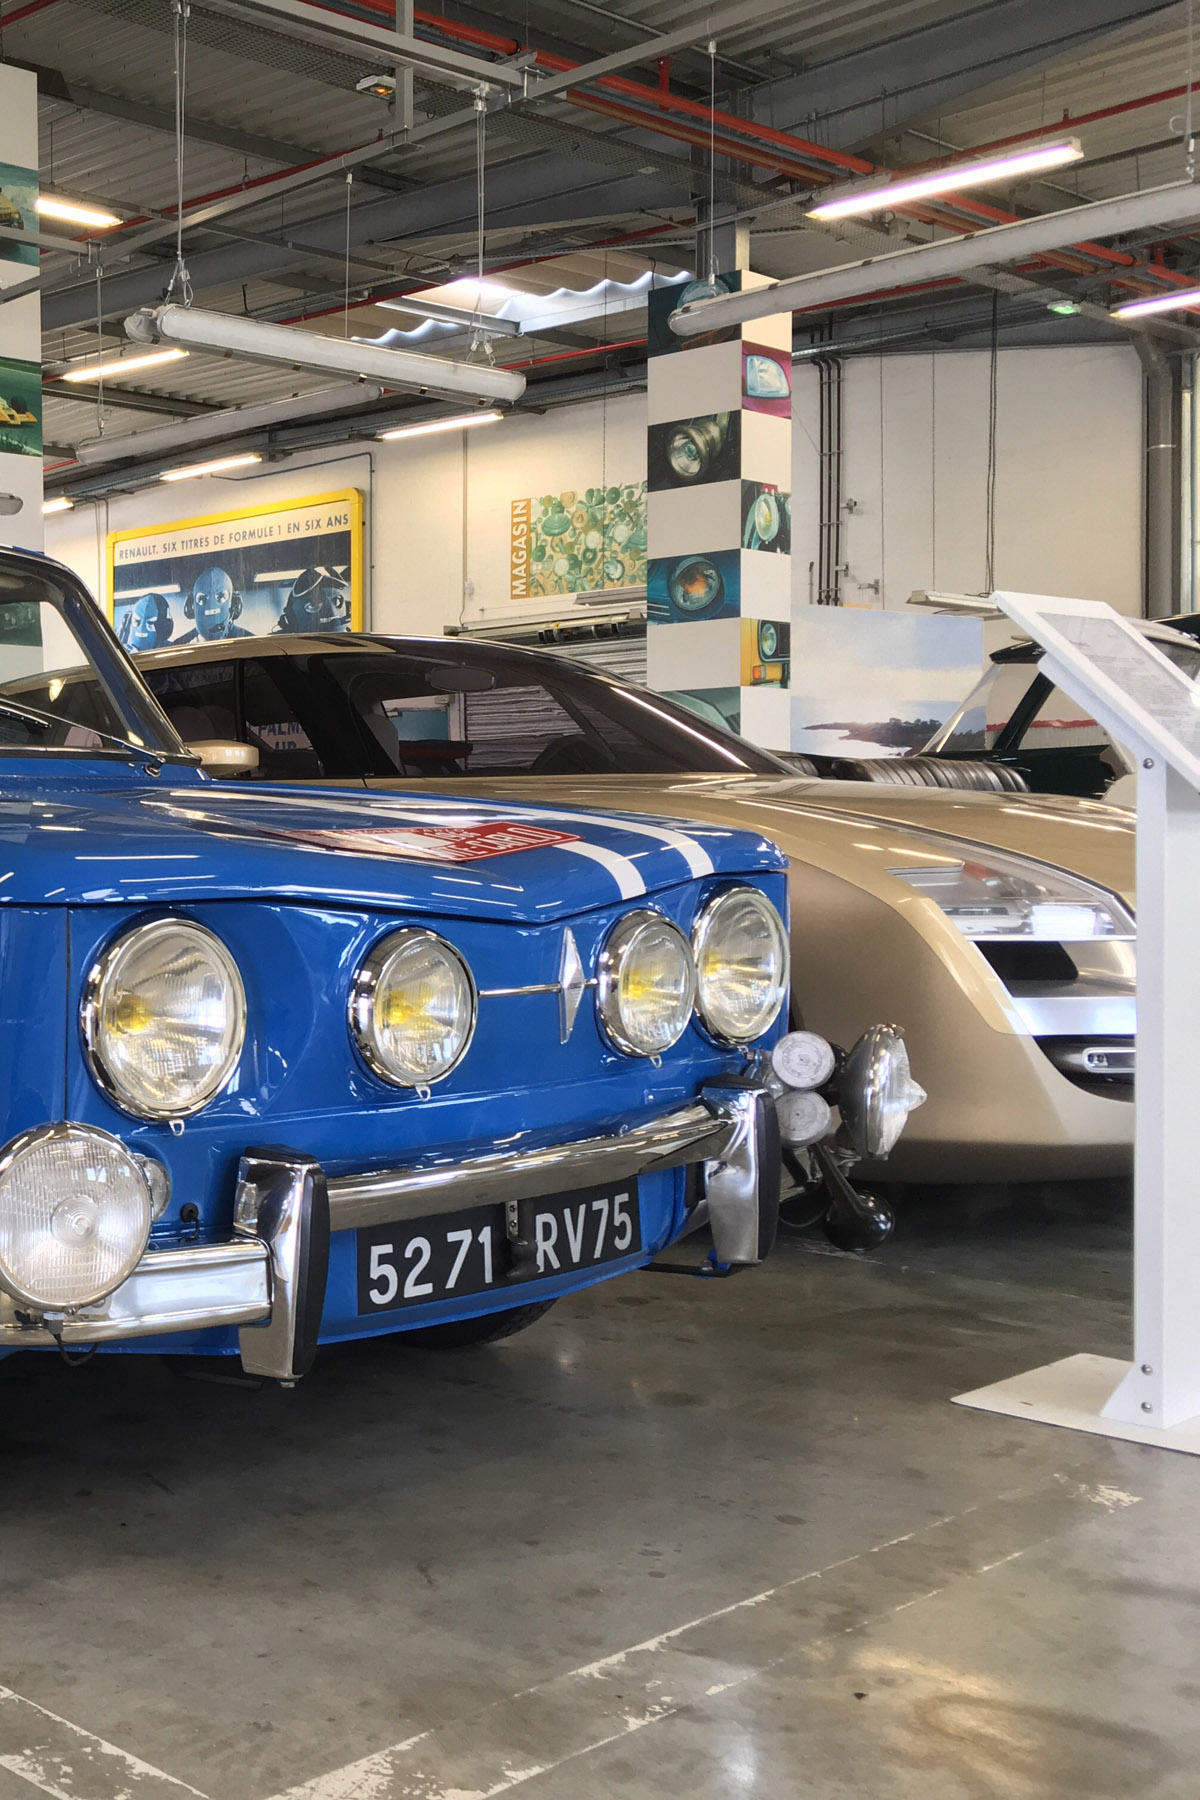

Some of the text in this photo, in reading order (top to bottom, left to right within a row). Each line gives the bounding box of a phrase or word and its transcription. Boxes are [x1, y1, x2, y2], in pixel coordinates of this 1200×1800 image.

[119, 513, 349, 560] RENAULT. SIX TITRES DE FORMULE 1 EN SIX ANS
[511, 500, 528, 596] MAGASIN
